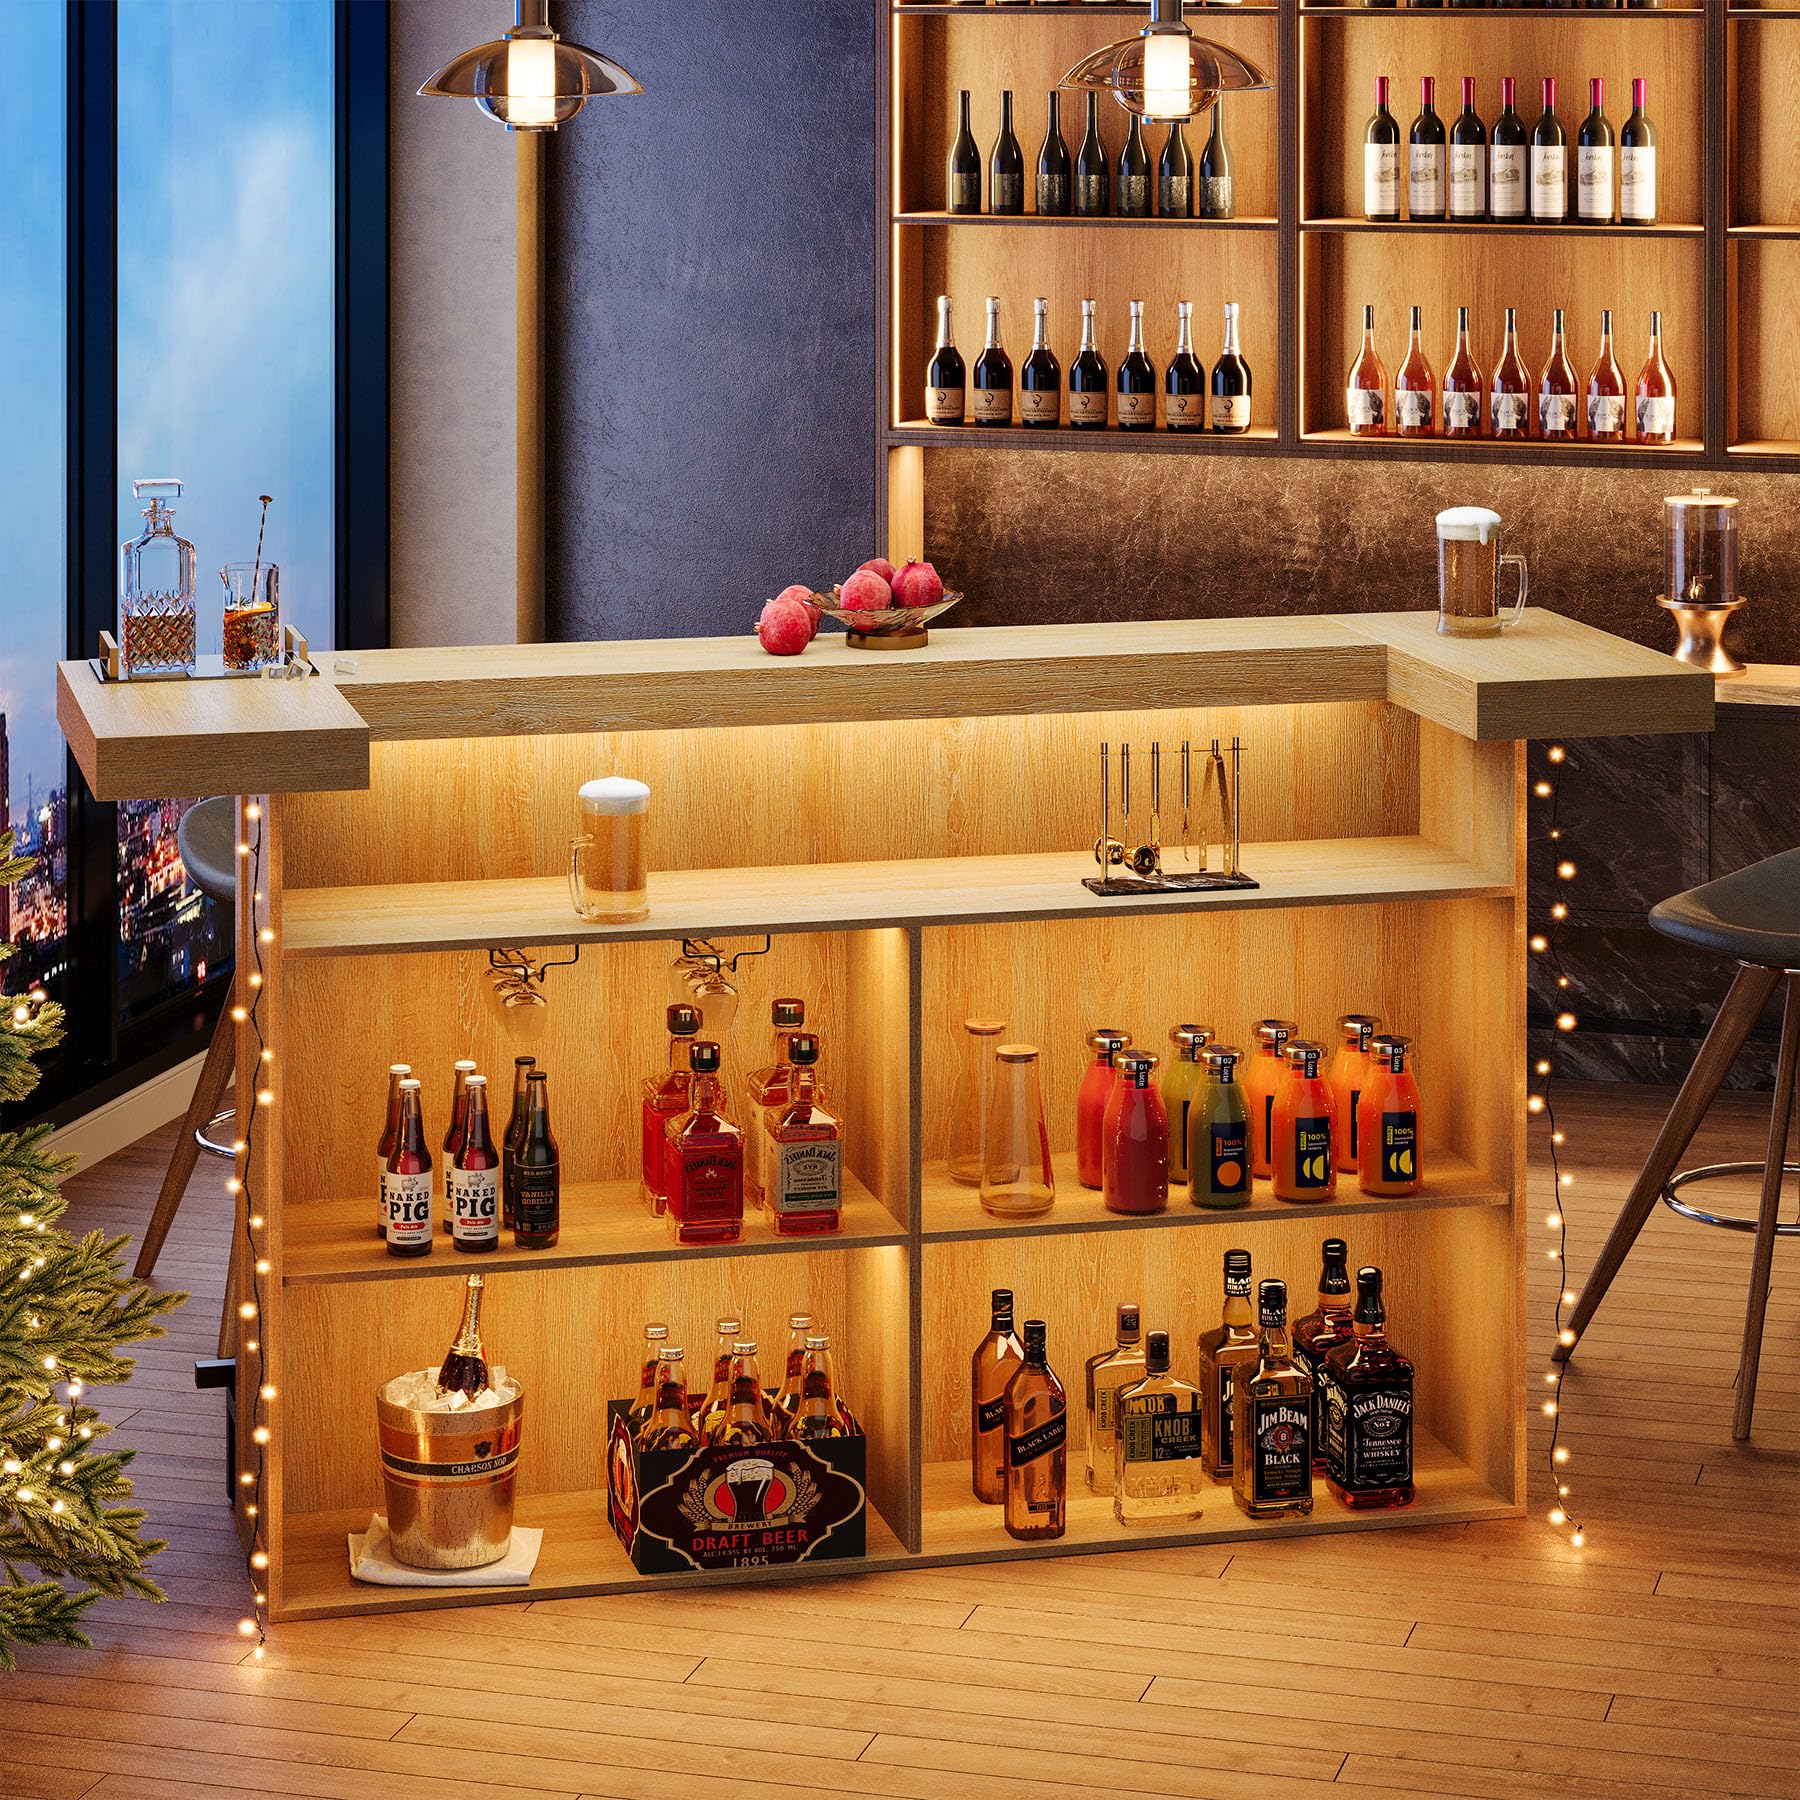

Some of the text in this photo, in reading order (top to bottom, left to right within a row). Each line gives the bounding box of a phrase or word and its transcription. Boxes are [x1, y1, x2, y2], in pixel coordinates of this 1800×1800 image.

[1224, 1139, 1242, 1147] 100%
[390, 1191, 430, 1202] NAKED
[456, 1186, 496, 1198] NAKED
[520, 1190, 555, 1198] VANILLA
[390, 1200, 430, 1222] PIG
[456, 1196, 496, 1218] PIG
[1228, 1276, 1252, 1285] BLAC
[1262, 1308, 1286, 1316] BLAC
[985, 1405, 1004, 1420] BLAC
[1353, 1394, 1412, 1418] JACK DANIEL'S
[1257, 1406, 1308, 1436] JIM BEAM
[1154, 1418, 1190, 1438] KNOB
[1161, 1434, 1197, 1444] CREEK
[1017, 1438, 1043, 1454] BLACK
[712, 1450, 750, 1463] PREMIUM
[1154, 1447, 1164, 1460] 12
[1264, 1453, 1300, 1466] BLACK
[1363, 1449, 1400, 1458] WHISKEY
[728, 1520, 773, 1530] BREWERY
[692, 1529, 809, 1552] DRAFT BEER
[734, 1555, 770, 1568] 1895
